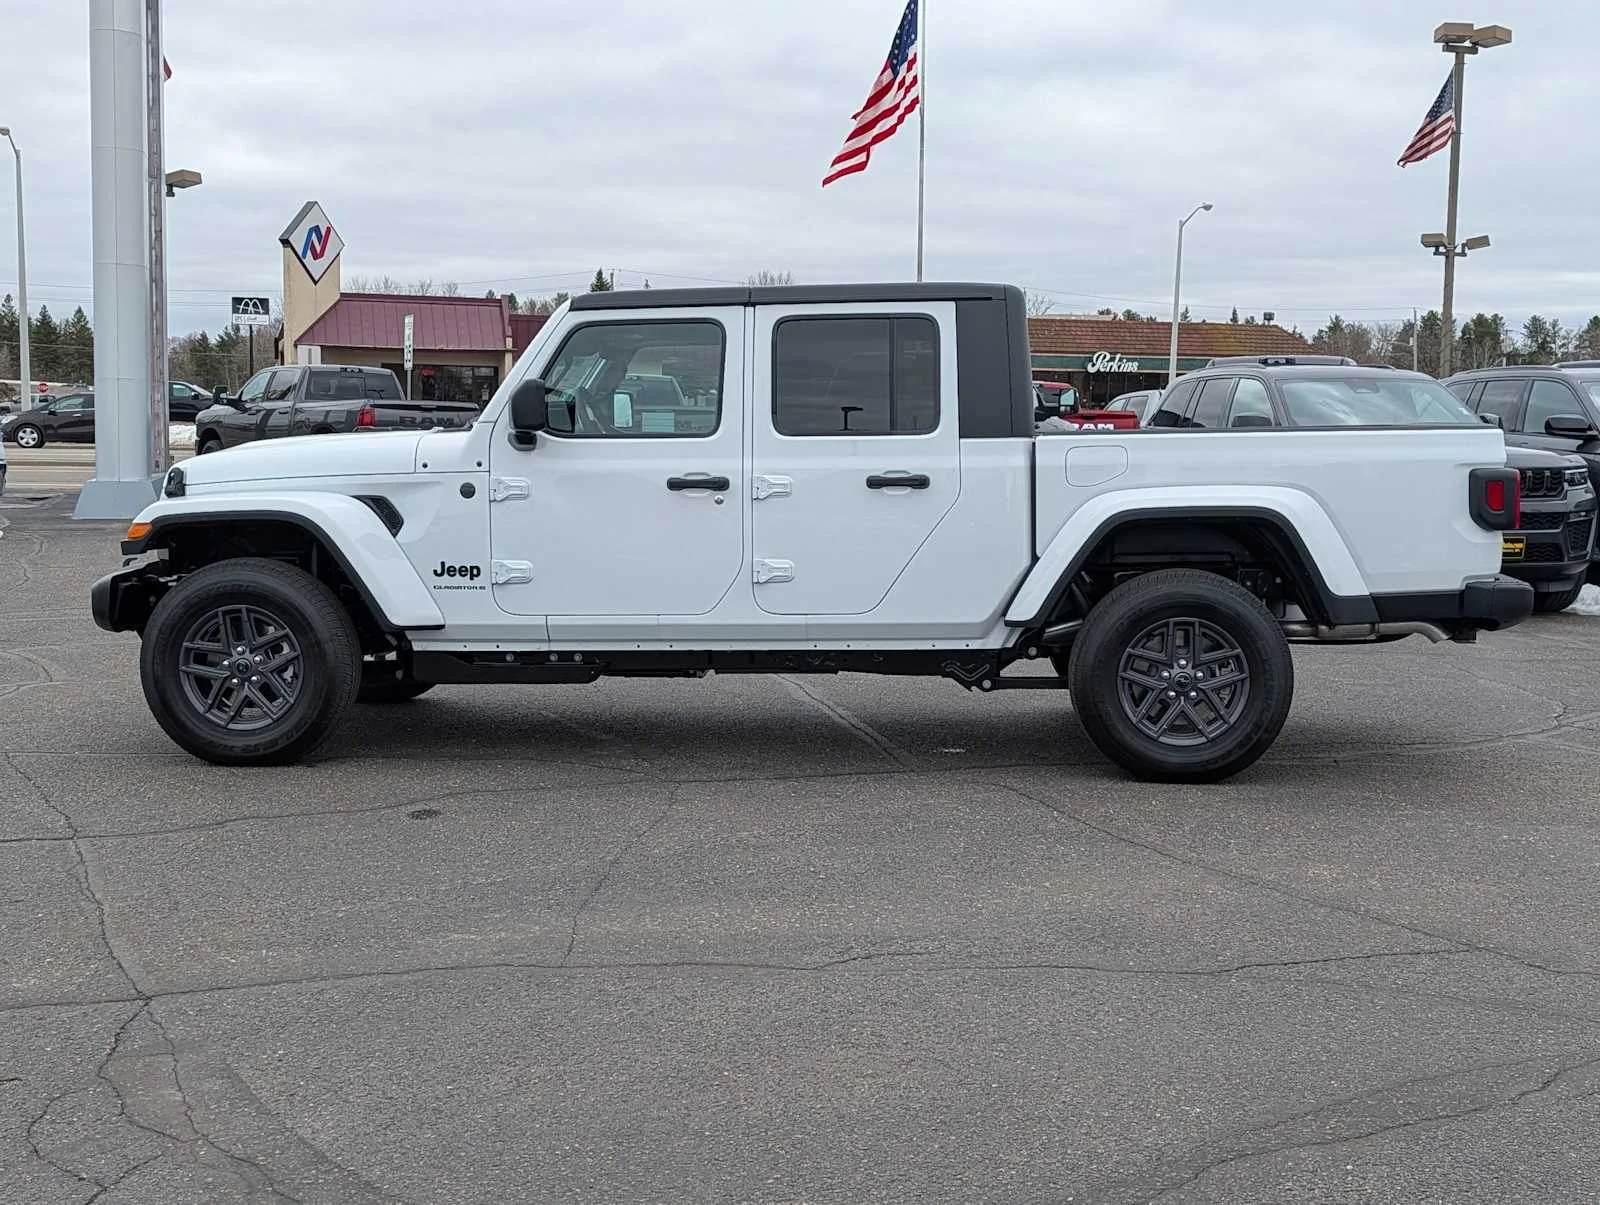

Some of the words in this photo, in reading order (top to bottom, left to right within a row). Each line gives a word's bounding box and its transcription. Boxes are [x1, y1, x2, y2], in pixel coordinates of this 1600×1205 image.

[1087, 351, 1139, 373] Perkins
[399, 416, 456, 427] RAM
[432, 561, 481, 581] Jeep
